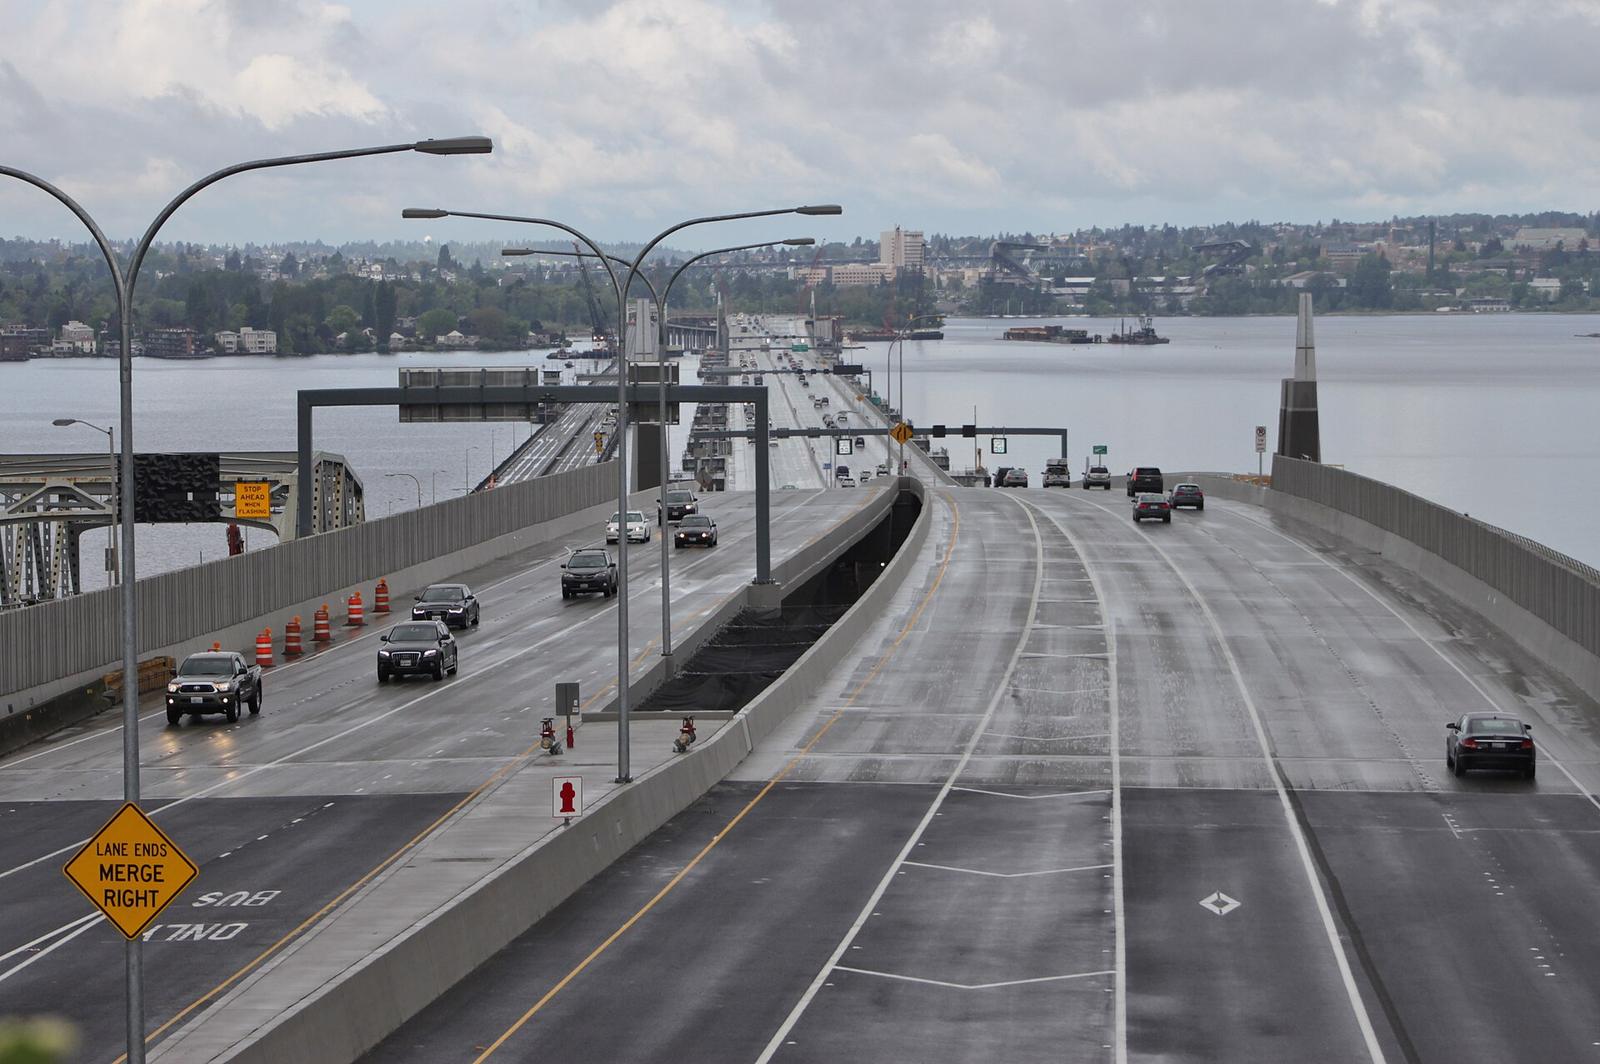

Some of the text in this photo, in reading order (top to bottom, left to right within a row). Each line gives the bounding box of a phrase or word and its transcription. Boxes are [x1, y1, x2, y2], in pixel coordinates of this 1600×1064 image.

[96, 842, 167, 857] LANE ENDS
[99, 863, 165, 883] MERGE
[104, 889, 160, 908] RIGHT
[192, 890, 282, 908] BUS
